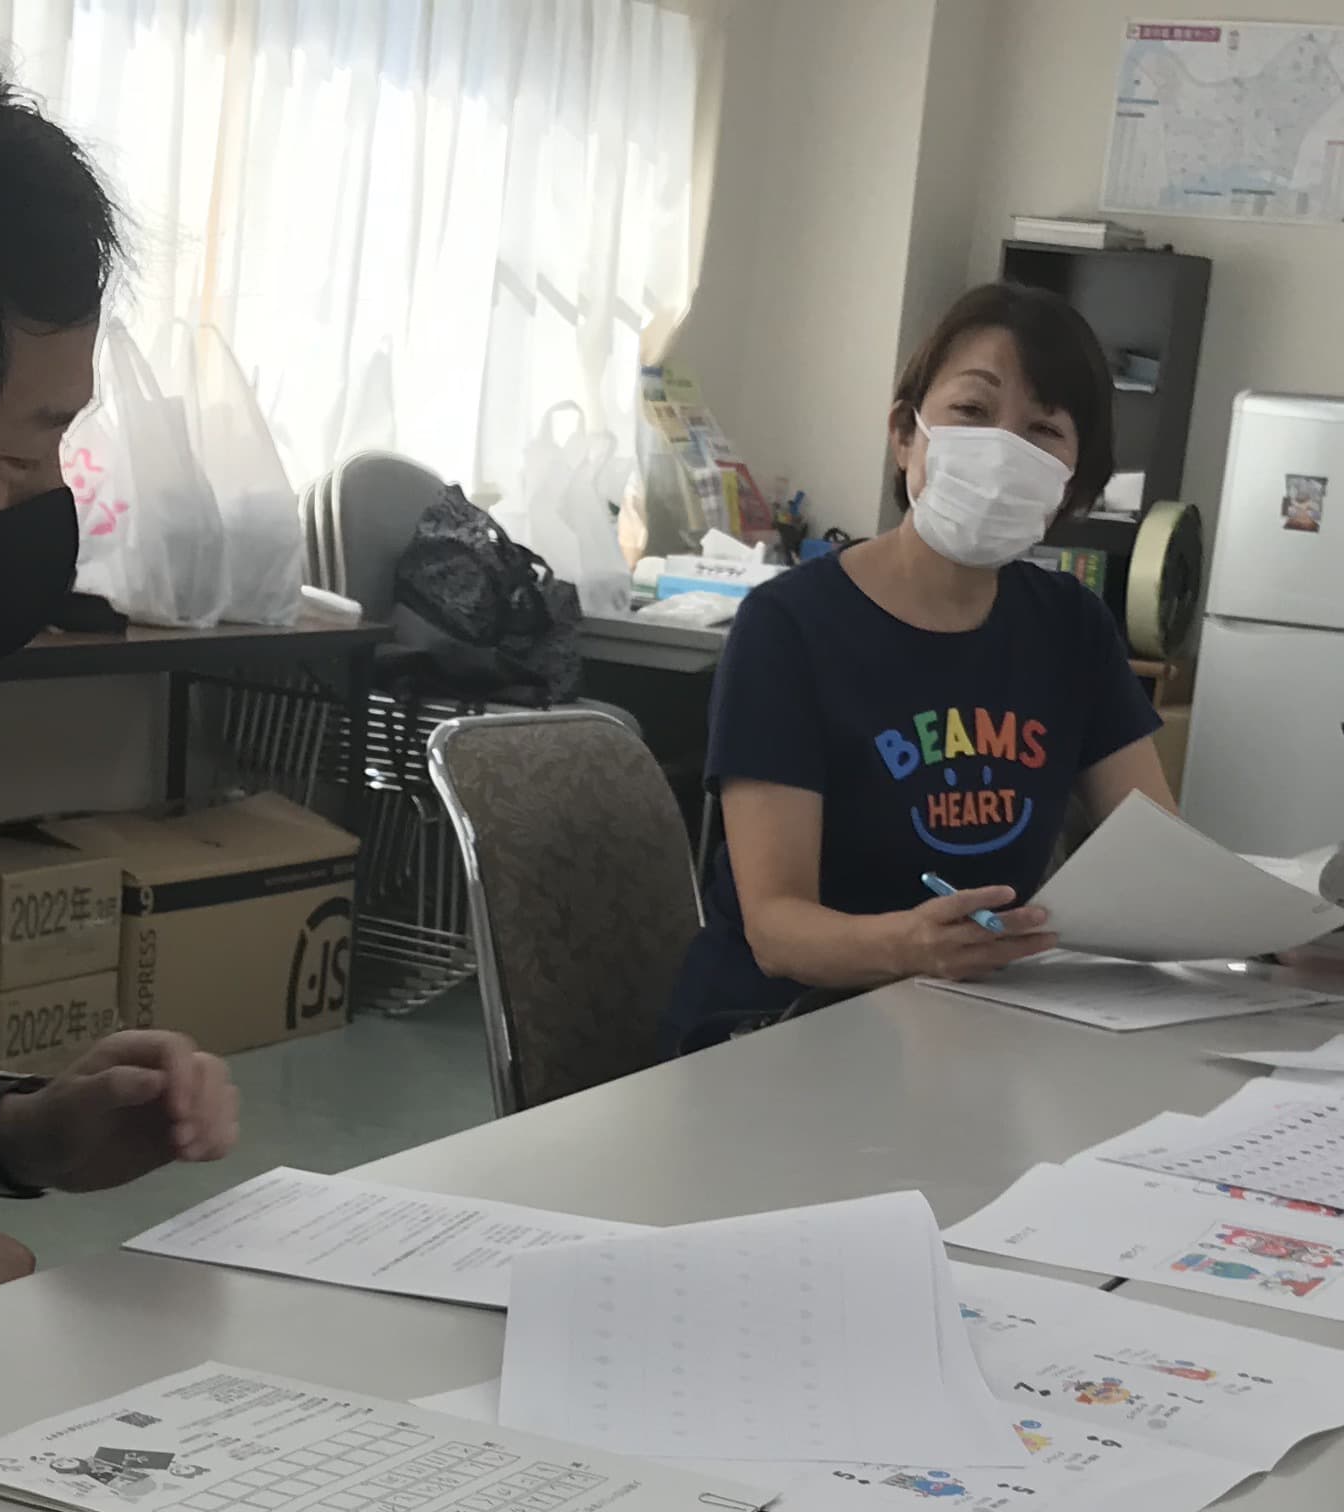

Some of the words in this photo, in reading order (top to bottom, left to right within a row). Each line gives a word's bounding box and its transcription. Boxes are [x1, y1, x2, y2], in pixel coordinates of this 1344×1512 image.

[874, 706, 1048, 780] BEAMS
[927, 789, 1016, 828] HEART
[9, 887, 92, 942] 2022年
[6, 1000, 89, 1058] 2022年
